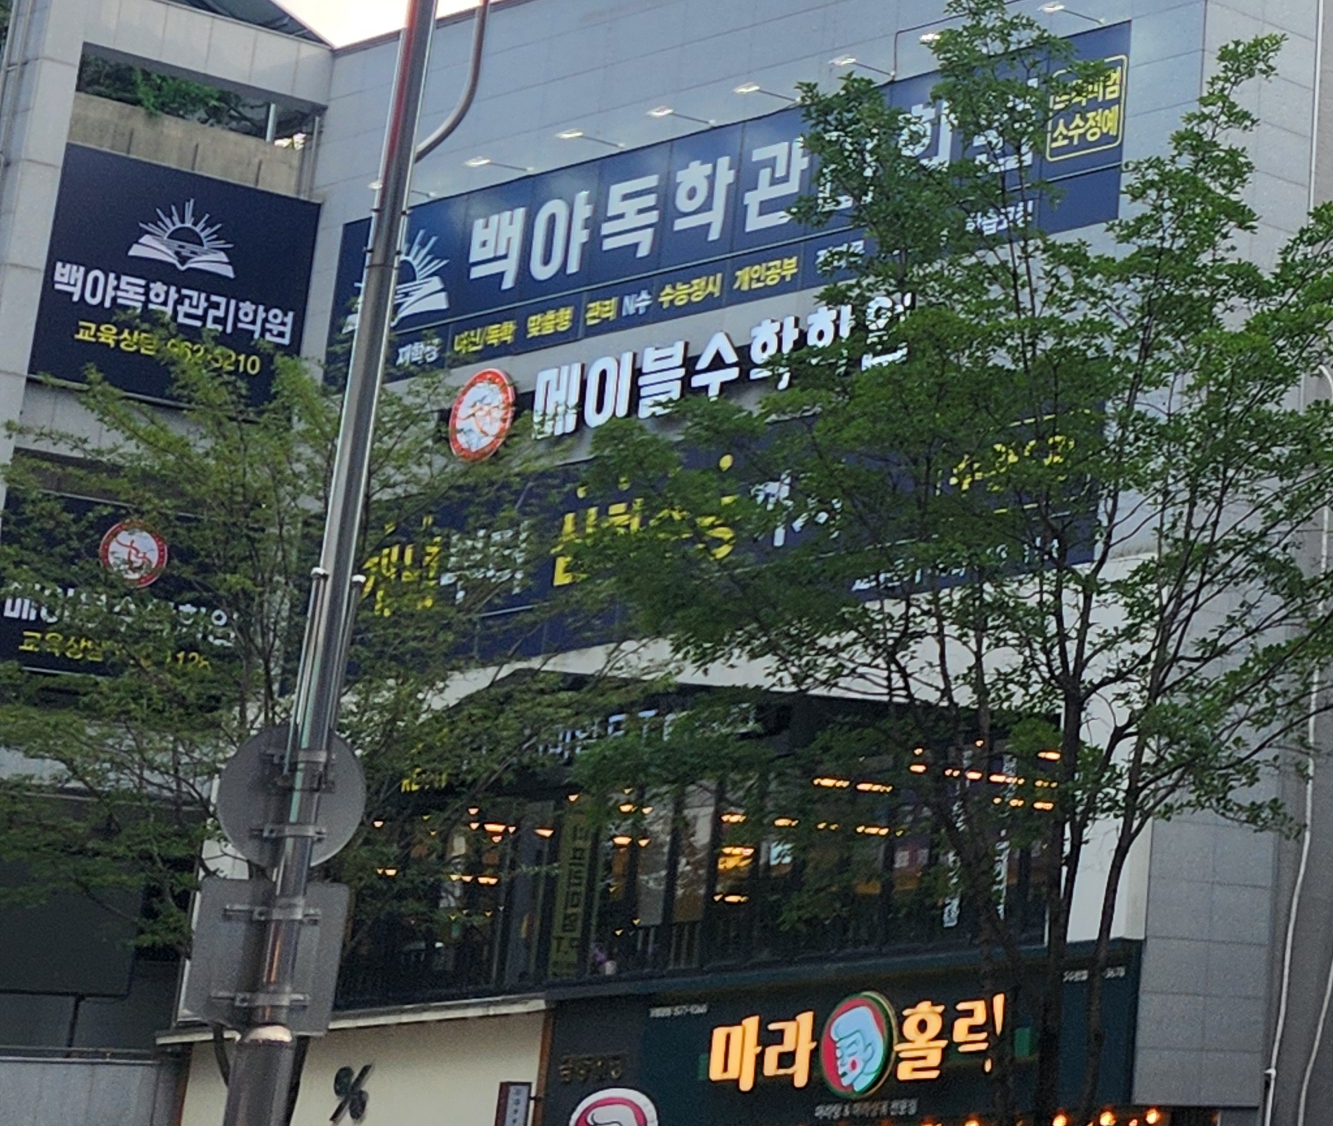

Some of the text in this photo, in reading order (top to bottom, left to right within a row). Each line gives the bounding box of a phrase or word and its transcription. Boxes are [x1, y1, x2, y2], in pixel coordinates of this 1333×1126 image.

[1050, 104, 1120, 149] 소수정예
[467, 77, 1036, 292] 백야독학관학
[53, 261, 295, 346] 백야독학관리학원
[622, 289, 653, 317] N수
[658, 272, 723, 309] 수능정시
[733, 255, 799, 292] 개인공부
[74, 320, 158, 356] 교육상담
[18, 630, 104, 662] 교육상
[708, 992, 1005, 1093] 마라 홀릭
